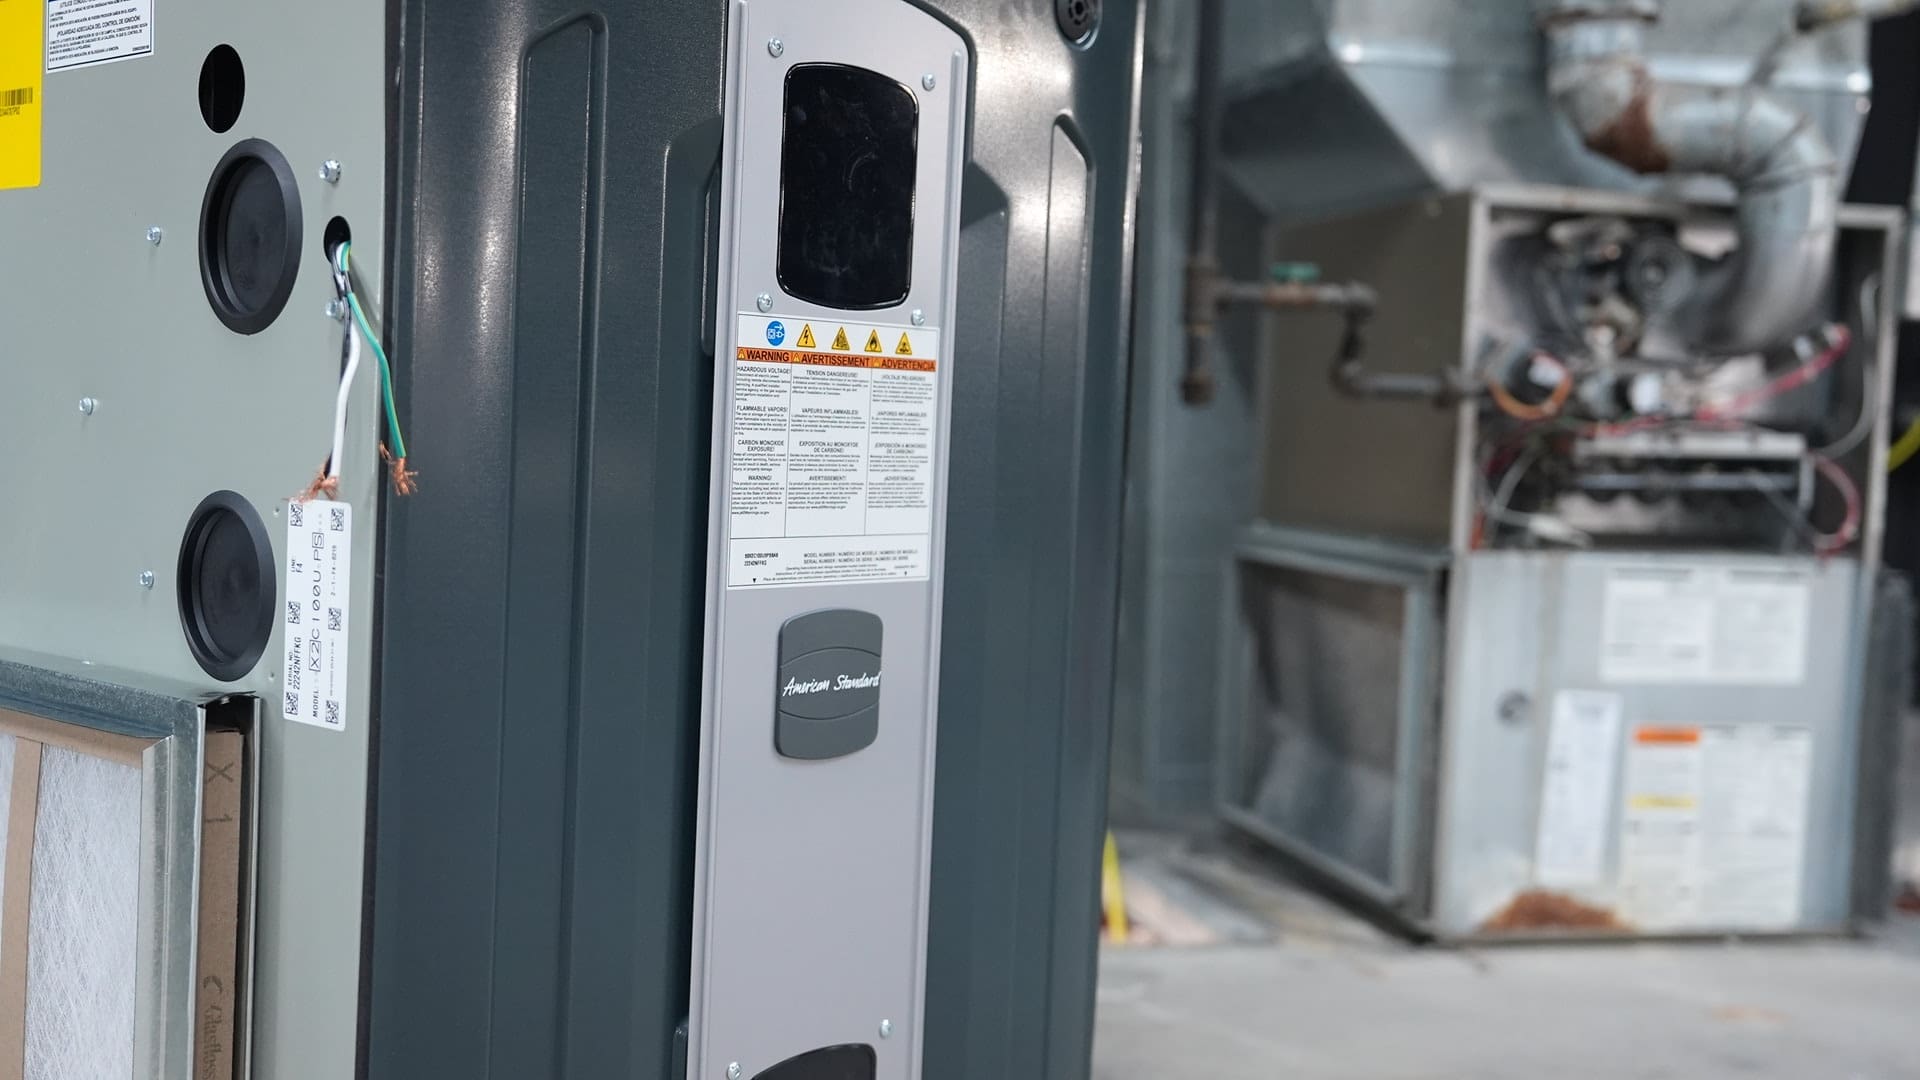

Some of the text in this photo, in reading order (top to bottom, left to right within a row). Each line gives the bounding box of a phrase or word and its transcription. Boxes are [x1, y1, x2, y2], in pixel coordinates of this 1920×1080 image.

[747, 350, 936, 371] WARNING AVERTISSEMENT ADVERTENCIA
[296, 563, 303, 573] F4
[293, 637, 301, 690] 22242NFFKG
[782, 671, 882, 696] American Standard
[207, 762, 234, 783] X
